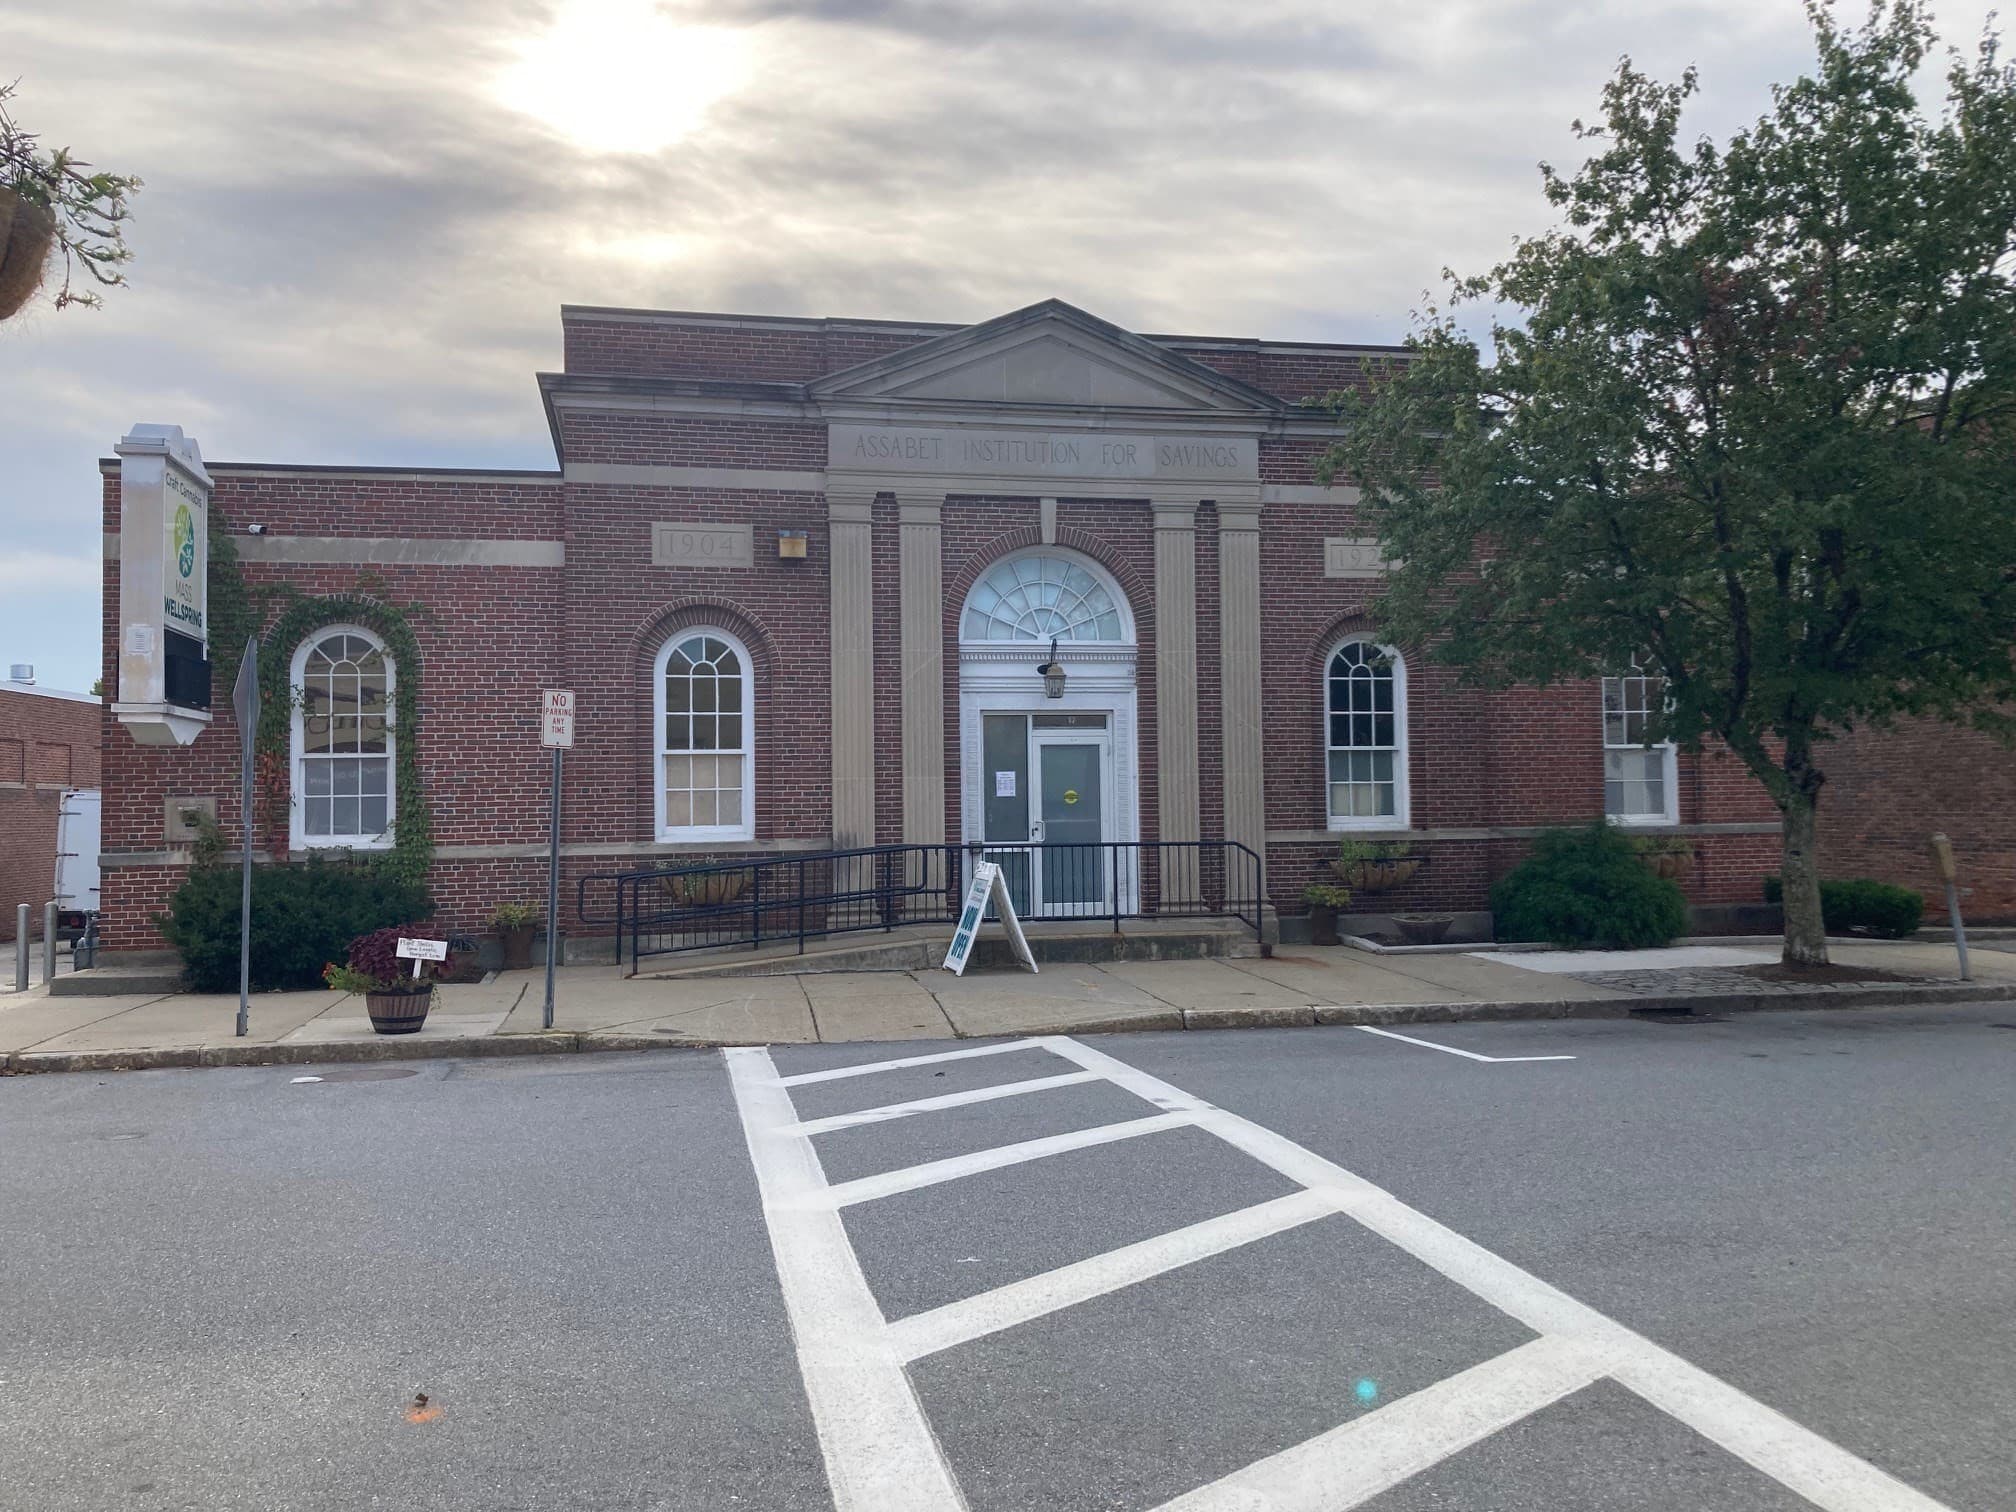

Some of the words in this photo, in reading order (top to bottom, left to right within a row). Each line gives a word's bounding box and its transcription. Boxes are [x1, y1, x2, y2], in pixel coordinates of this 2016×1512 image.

[854, 435, 944, 461] ASSABET
[963, 438, 1080, 464] INSTITUTION
[1102, 443, 1138, 466] FOR
[1160, 444, 1239, 469] SAVINGS
[166, 472, 179, 492] Craft
[180, 482, 202, 509] Cannabis
[669, 533, 734, 556] 1904
[1338, 547, 1379, 568] 192
[175, 579, 192, 603] MASS
[164, 595, 202, 628] WELLSPRING
[545, 707, 572, 716] PARKING
[552, 695, 567, 707] NO
[552, 717, 565, 725] ANY
[552, 725, 565, 734] TIME
